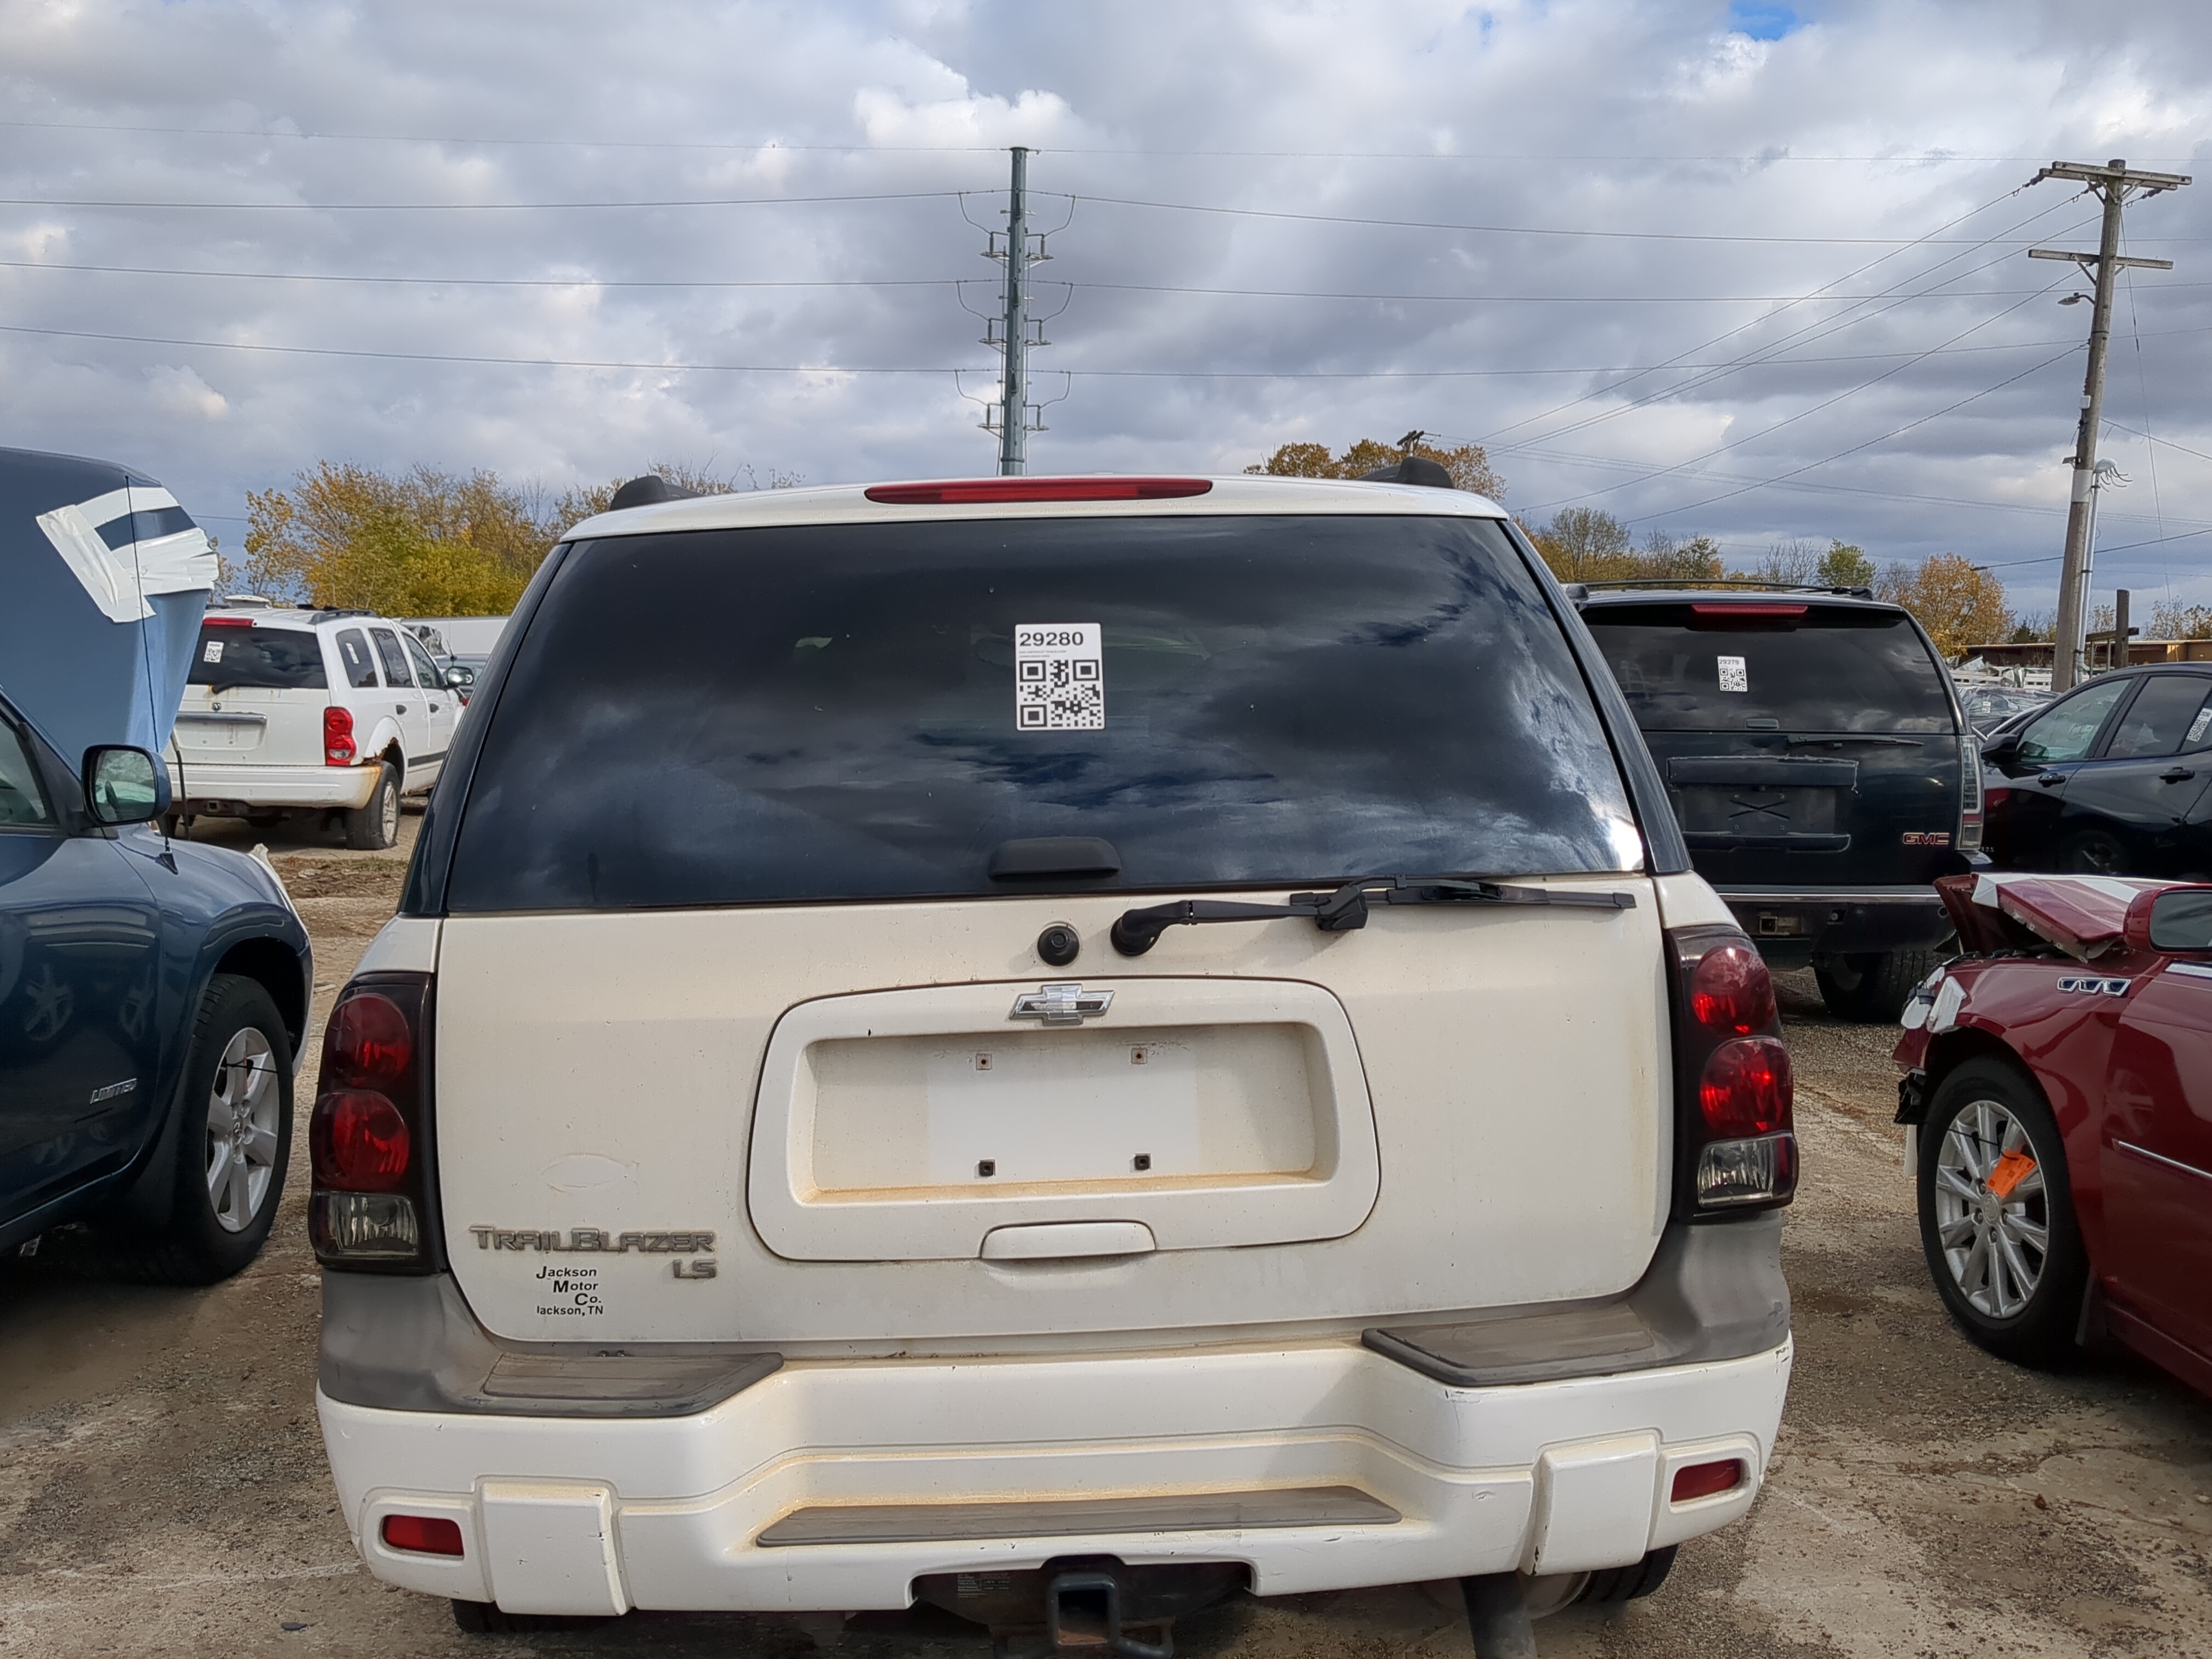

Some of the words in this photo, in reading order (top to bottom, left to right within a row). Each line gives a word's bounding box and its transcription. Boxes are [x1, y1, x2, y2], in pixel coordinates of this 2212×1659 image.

[1019, 631, 1084, 647] 29280
[1902, 832, 1950, 845] GMC
[469, 1226, 715, 1252] TRAILBLAZER
[535, 1266, 597, 1279] Jackson
[673, 1259, 716, 1279] LS
[553, 1280, 599, 1293] Motor
[574, 1293, 602, 1306] Co.
